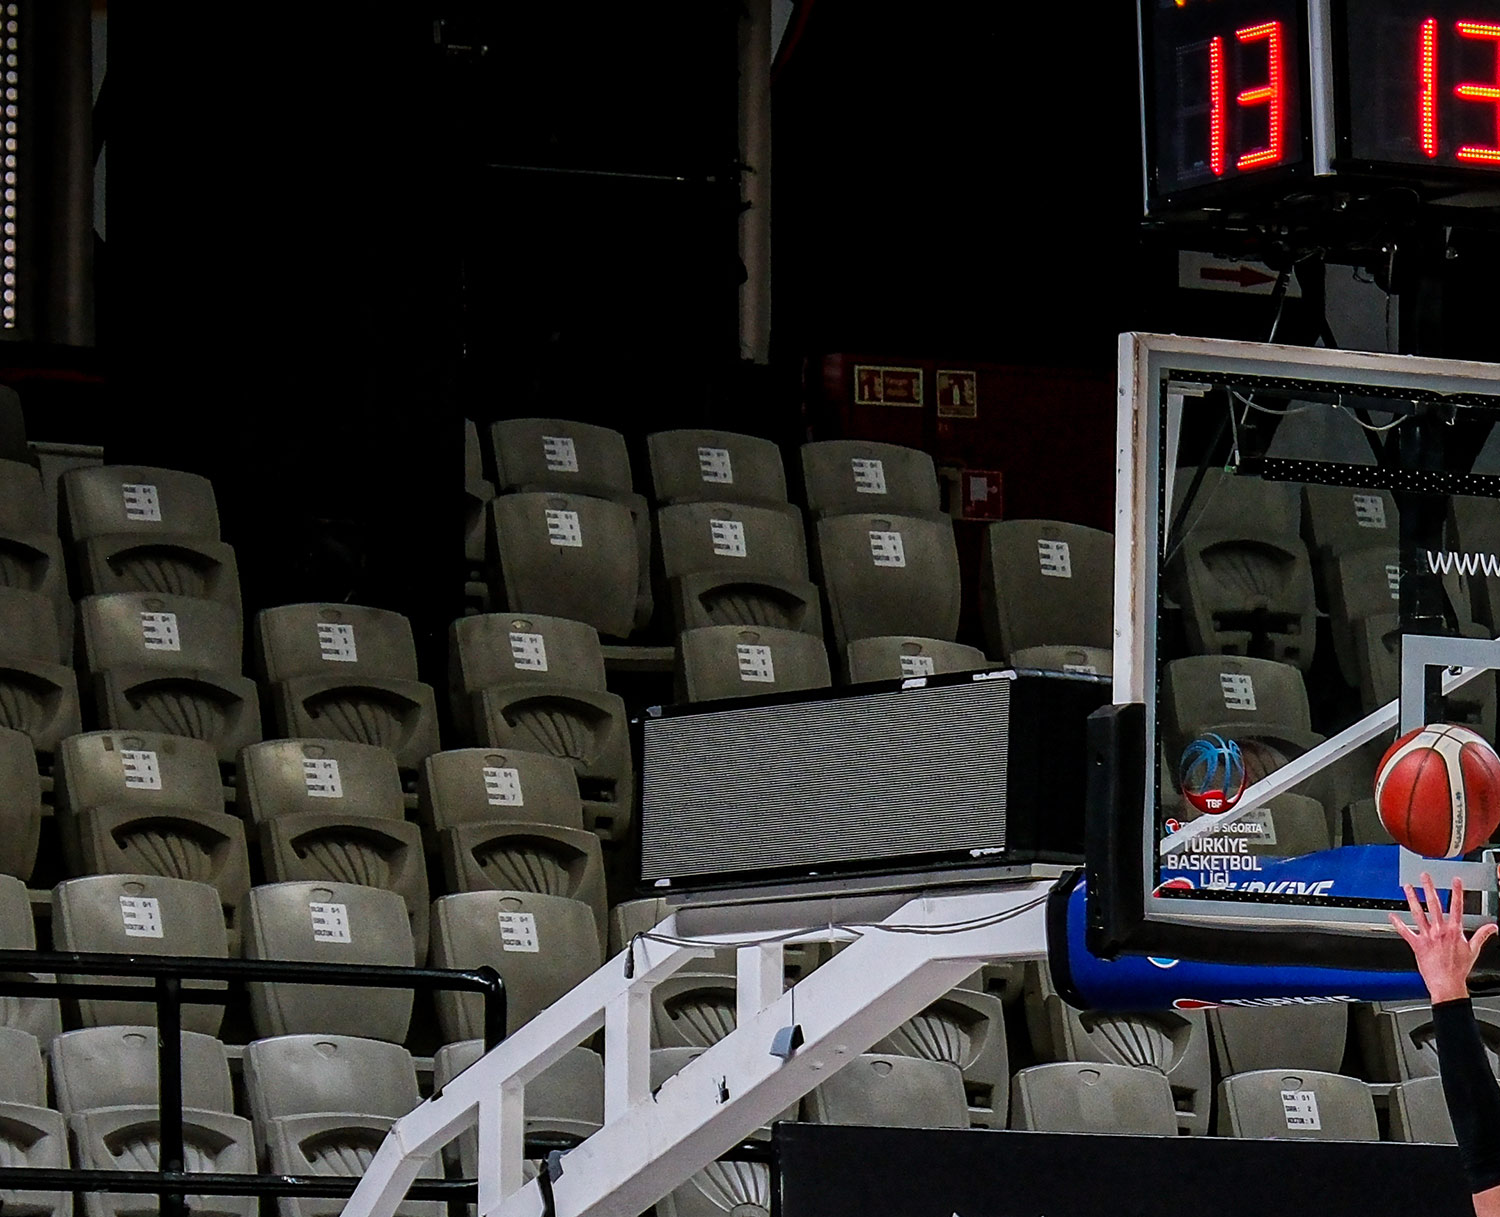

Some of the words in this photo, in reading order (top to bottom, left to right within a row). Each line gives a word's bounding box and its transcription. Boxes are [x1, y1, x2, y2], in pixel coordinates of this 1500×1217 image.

[1209, 19, 1284, 177] 13
[1205, 798, 1223, 809] TBF
[1167, 855, 1262, 871] BASKETBOL
[1200, 870, 1230, 888] LİGİ
